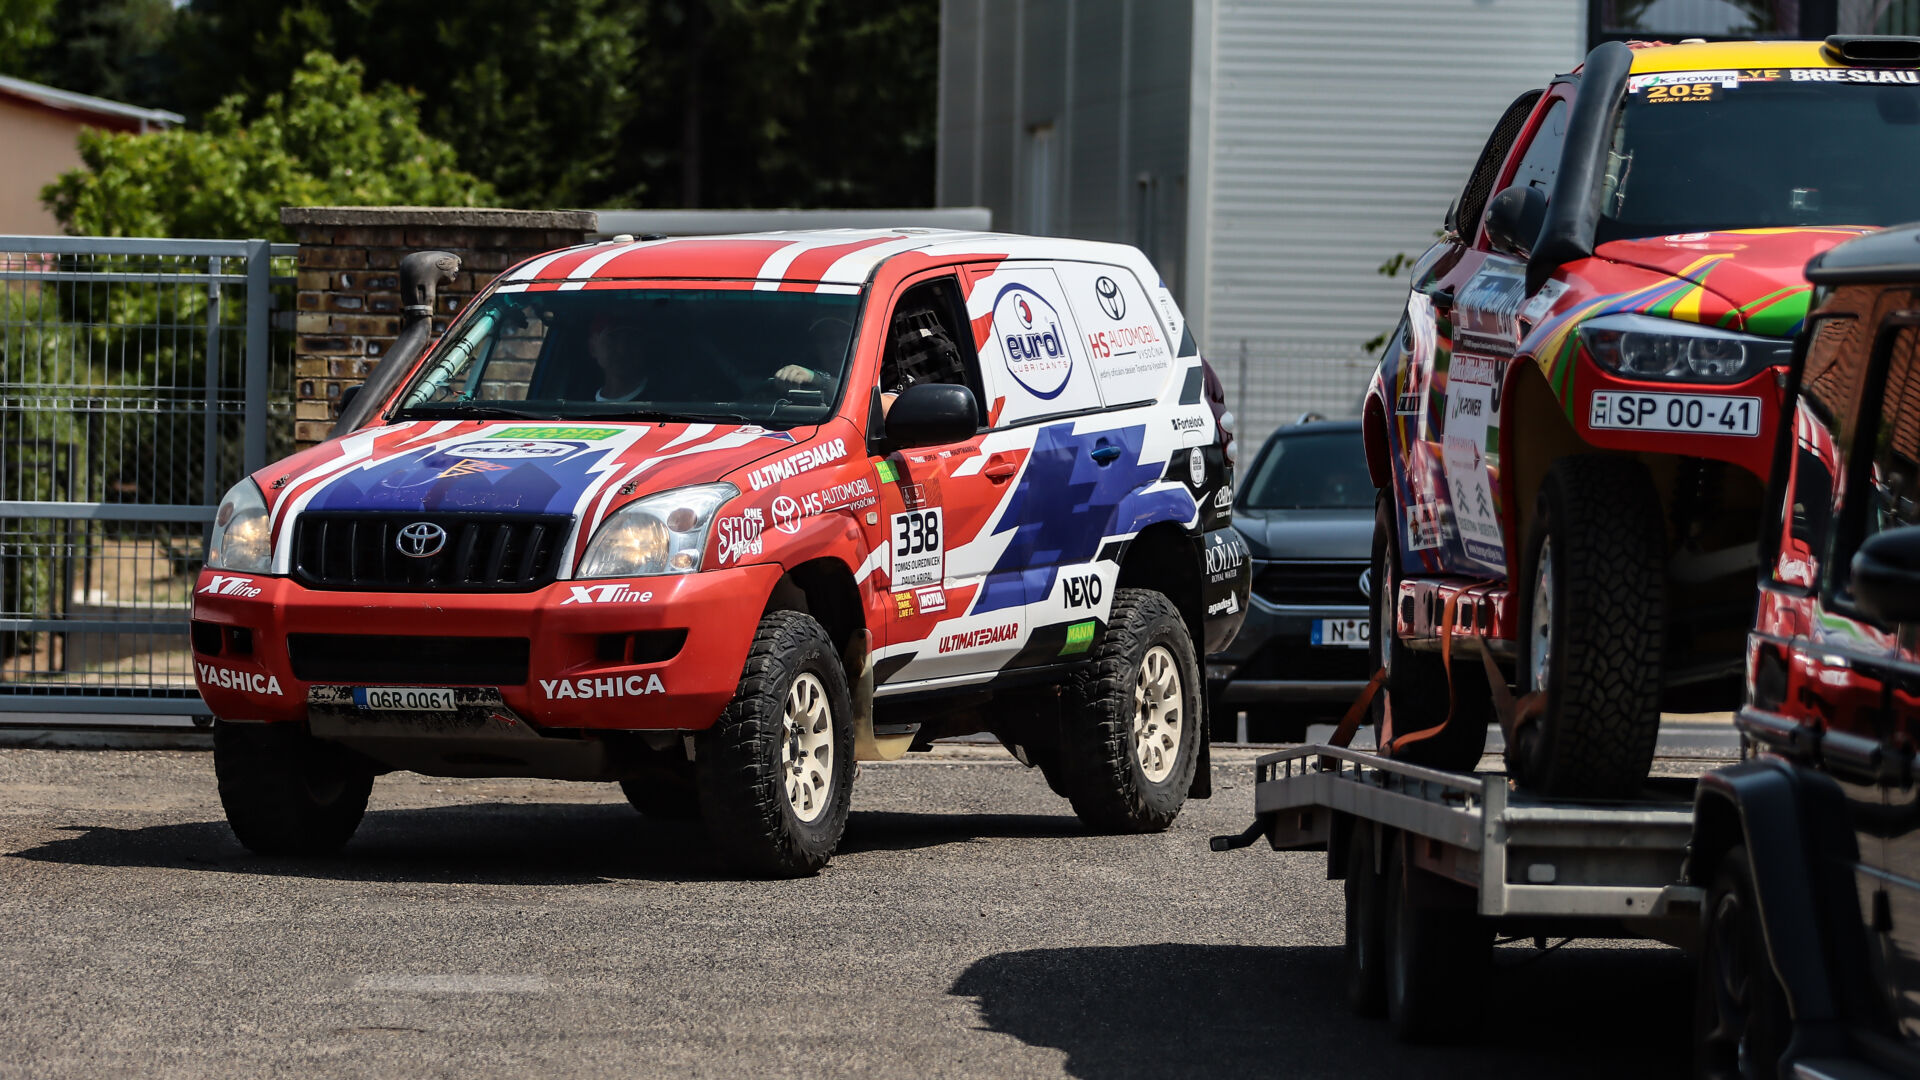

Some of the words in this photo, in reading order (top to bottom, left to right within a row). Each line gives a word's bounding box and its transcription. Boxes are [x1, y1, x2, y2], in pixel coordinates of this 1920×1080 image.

[1659, 76, 1736, 84] K-POWER
[1647, 84, 1713, 98] 205
[1006, 322, 1065, 362] eurol
[1088, 332, 1110, 359] HS
[1109, 325, 1160, 348] AUTOMOBIL
[1013, 361, 1069, 373] LUBRICANTS
[1595, 411, 1606, 424] H
[1617, 396, 1657, 426] SP
[1666, 399, 1749, 430] 00-41
[1177, 416, 1204, 430] Fortelock
[801, 492, 823, 517] HS
[821, 477, 874, 506] AUTOMOBIL
[744, 508, 762, 518] ONE
[718, 517, 764, 564] SHOT
[896, 511, 939, 556] 338
[1205, 541, 1242, 575] ROYAL
[920, 592, 944, 607] MOTUL
[1063, 574, 1102, 609] NEXO
[1208, 598, 1231, 615] agados
[1068, 624, 1094, 640] MANN
[1331, 622, 1345, 641] N
[198, 662, 283, 696] YASHICA
[539, 673, 666, 699] YASHICA
[369, 691, 405, 709] 06R
[406, 691, 453, 709] 0061
